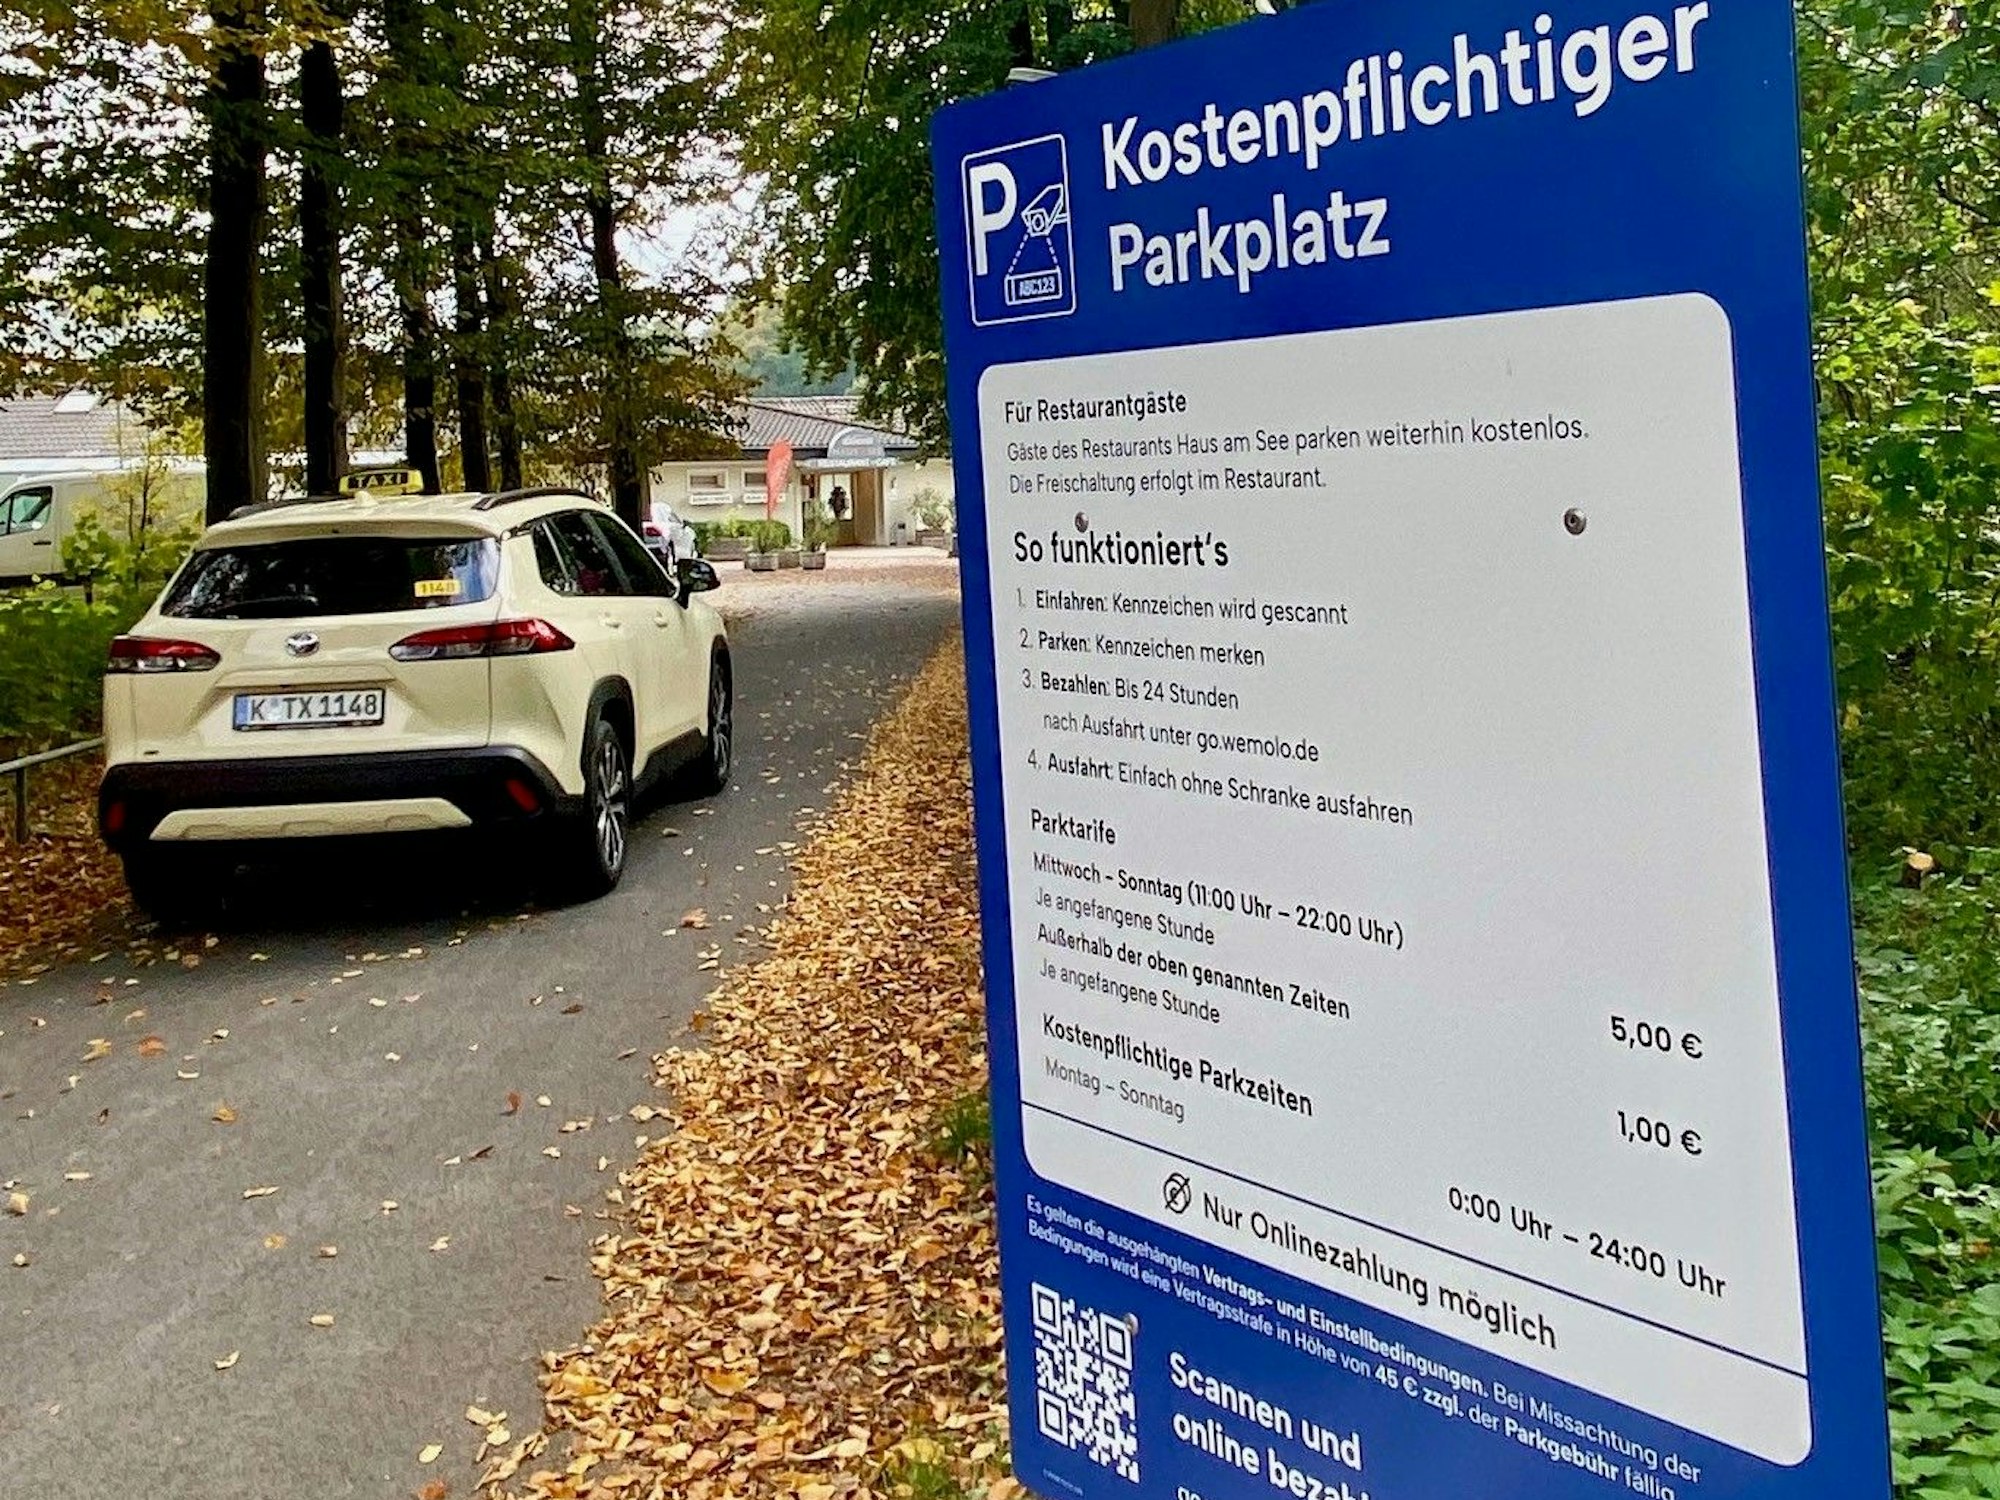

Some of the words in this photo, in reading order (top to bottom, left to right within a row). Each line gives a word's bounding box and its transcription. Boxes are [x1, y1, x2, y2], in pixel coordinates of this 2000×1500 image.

[1102, 2, 1709, 190] Kostenpflichtiger
[969, 162, 1017, 276] P
[1109, 191, 1390, 293] Parkplatz
[1005, 401, 1031, 423] Für
[1037, 390, 1187, 421] Restaurantgäste
[1008, 442, 1047, 461] Gäste
[1052, 440, 1077, 459] des
[1082, 436, 1172, 458] Restaurants
[1177, 434, 1218, 454] Haus
[1223, 436, 1249, 451] am
[1256, 430, 1289, 450] See
[1296, 425, 1360, 455] parken
[1366, 419, 1464, 447] weiterhin
[1471, 413, 1590, 443] kostenlos.
[356, 475, 401, 488] TAXI
[1010, 474, 1032, 494] Die
[1037, 471, 1135, 496] Freischaltung
[1140, 469, 1193, 495] erfolgt
[1199, 470, 1219, 490] im
[1225, 466, 1327, 490] Restaurant.
[1014, 531, 1042, 562] So
[1036, 589, 1108, 612] Einfahren:
[1113, 593, 1214, 618] Kennzeichen
[1220, 597, 1256, 620] wird
[1262, 601, 1348, 626] gescannt
[1020, 628, 1034, 649] 2.
[1038, 630, 1091, 653] Parken:
[1096, 634, 1195, 661] Kennzeichen
[1200, 643, 1265, 666] merken
[251, 699, 266, 721] K
[1022, 668, 1036, 689] 3.
[1041, 671, 1110, 697] Bezahlen:
[1115, 678, 1138, 700] Bis
[1143, 681, 1164, 702] 24
[1170, 683, 1239, 710] Stunden
[1043, 712, 1078, 732] nach
[1082, 714, 1145, 742] Ausfahrt
[1150, 724, 1192, 747] unter
[1197, 729, 1319, 762] go.wemolo.de
[1027, 748, 1042, 770] 4.
[1048, 752, 1114, 780] Ausfahrt:
[1119, 762, 1176, 791] Einfach
[1182, 771, 1223, 798] ohne
[1229, 778, 1310, 810] Schranke
[1316, 793, 1413, 826] ausfahren
[1031, 807, 1116, 846] Parktarife
[1033, 852, 1101, 884] Mittwoch
[1118, 869, 1182, 905] Sonntag
[1188, 880, 1235, 912] (11:00
[1241, 894, 1272, 920] Uhr
[1295, 905, 1351, 936] 22:00
[1359, 919, 1403, 951] Uhr)
[1036, 888, 1052, 908] Je
[1056, 894, 1152, 931] angefangene
[1157, 913, 1215, 946] Stunde
[1037, 923, 1113, 959] Außerhalb
[1117, 943, 1142, 967] der
[1148, 952, 1188, 979] oben
[1192, 964, 1284, 1003] genannten
[1289, 983, 1350, 1020] Zeiten
[1040, 958, 1056, 979] Je
[1061, 965, 1157, 1007] angefangene
[1162, 990, 1220, 1024] Stunde
[1043, 1012, 1193, 1080] Kostenpflichtige
[1199, 1059, 1313, 1117] Parkzeiten
[1611, 1015, 1671, 1052] 5,00
[1681, 1034, 1703, 1059] €
[1045, 1056, 1101, 1096] Montag
[1120, 1080, 1185, 1124] Sonntag
[1617, 1110, 1670, 1148] 1,00
[1681, 1130, 1702, 1155] €
[1203, 1192, 1243, 1230] Nur
[1251, 1213, 1428, 1305] Onlinezahlung
[1439, 1285, 1557, 1349] möglich
[1449, 1187, 1500, 1223] 0:00
[1511, 1206, 1552, 1241] Uhr
[1589, 1233, 1666, 1278] 24:00
[1678, 1259, 1726, 1298] Uhr
[1026, 1194, 1042, 1215] Es
[1044, 1205, 1082, 1231] gelten
[1084, 1219, 1105, 1241] die
[1107, 1230, 1200, 1280] ausgehängten
[1203, 1264, 1274, 1307] Vertrags-
[1277, 1299, 1306, 1323] und
[1310, 1309, 1489, 1398] Einstellbedingungen.
[1493, 1383, 1524, 1411] Bei
[1529, 1396, 1658, 1471] Missachtung
[1664, 1452, 1701, 1484] der
[1028, 1219, 1109, 1268] Bedingungen
[1110, 1256, 1139, 1280] wird
[1141, 1269, 1171, 1293] eine
[1172, 1279, 1273, 1336] Vertragsstrafe
[1276, 1320, 1291, 1342] in
[1294, 1330, 1337, 1364] Höhe
[1341, 1351, 1371, 1378] von
[1374, 1363, 1399, 1389] 45
[1402, 1375, 1419, 1398] €
[1422, 1386, 1464, 1418] zzgl.
[1468, 1406, 1501, 1431] der
[1504, 1415, 1619, 1482] Parkgebühr
[1170, 1351, 1293, 1440] Scannen
[1301, 1418, 1363, 1472] und
[1173, 1412, 1260, 1476] online
